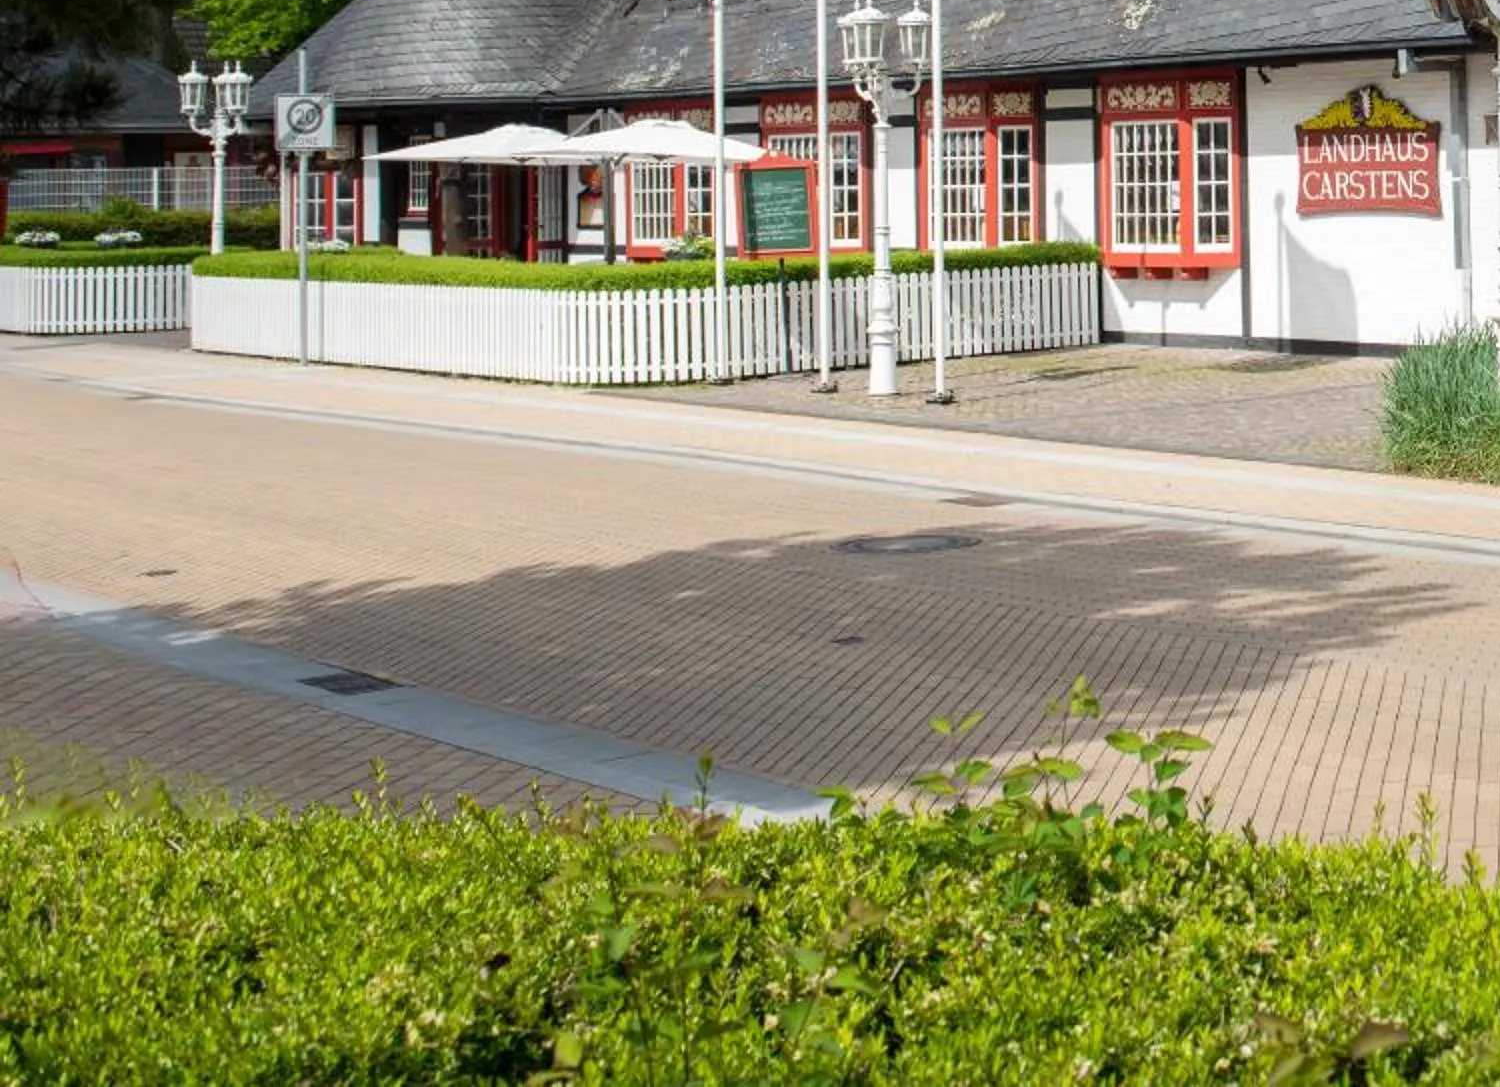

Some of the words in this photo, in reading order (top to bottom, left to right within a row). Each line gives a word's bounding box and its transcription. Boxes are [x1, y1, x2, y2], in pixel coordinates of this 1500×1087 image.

[294, 108, 317, 126] 20
[1303, 133, 1429, 164] LANDHAUS
[1303, 170, 1430, 200] CARSTENS
